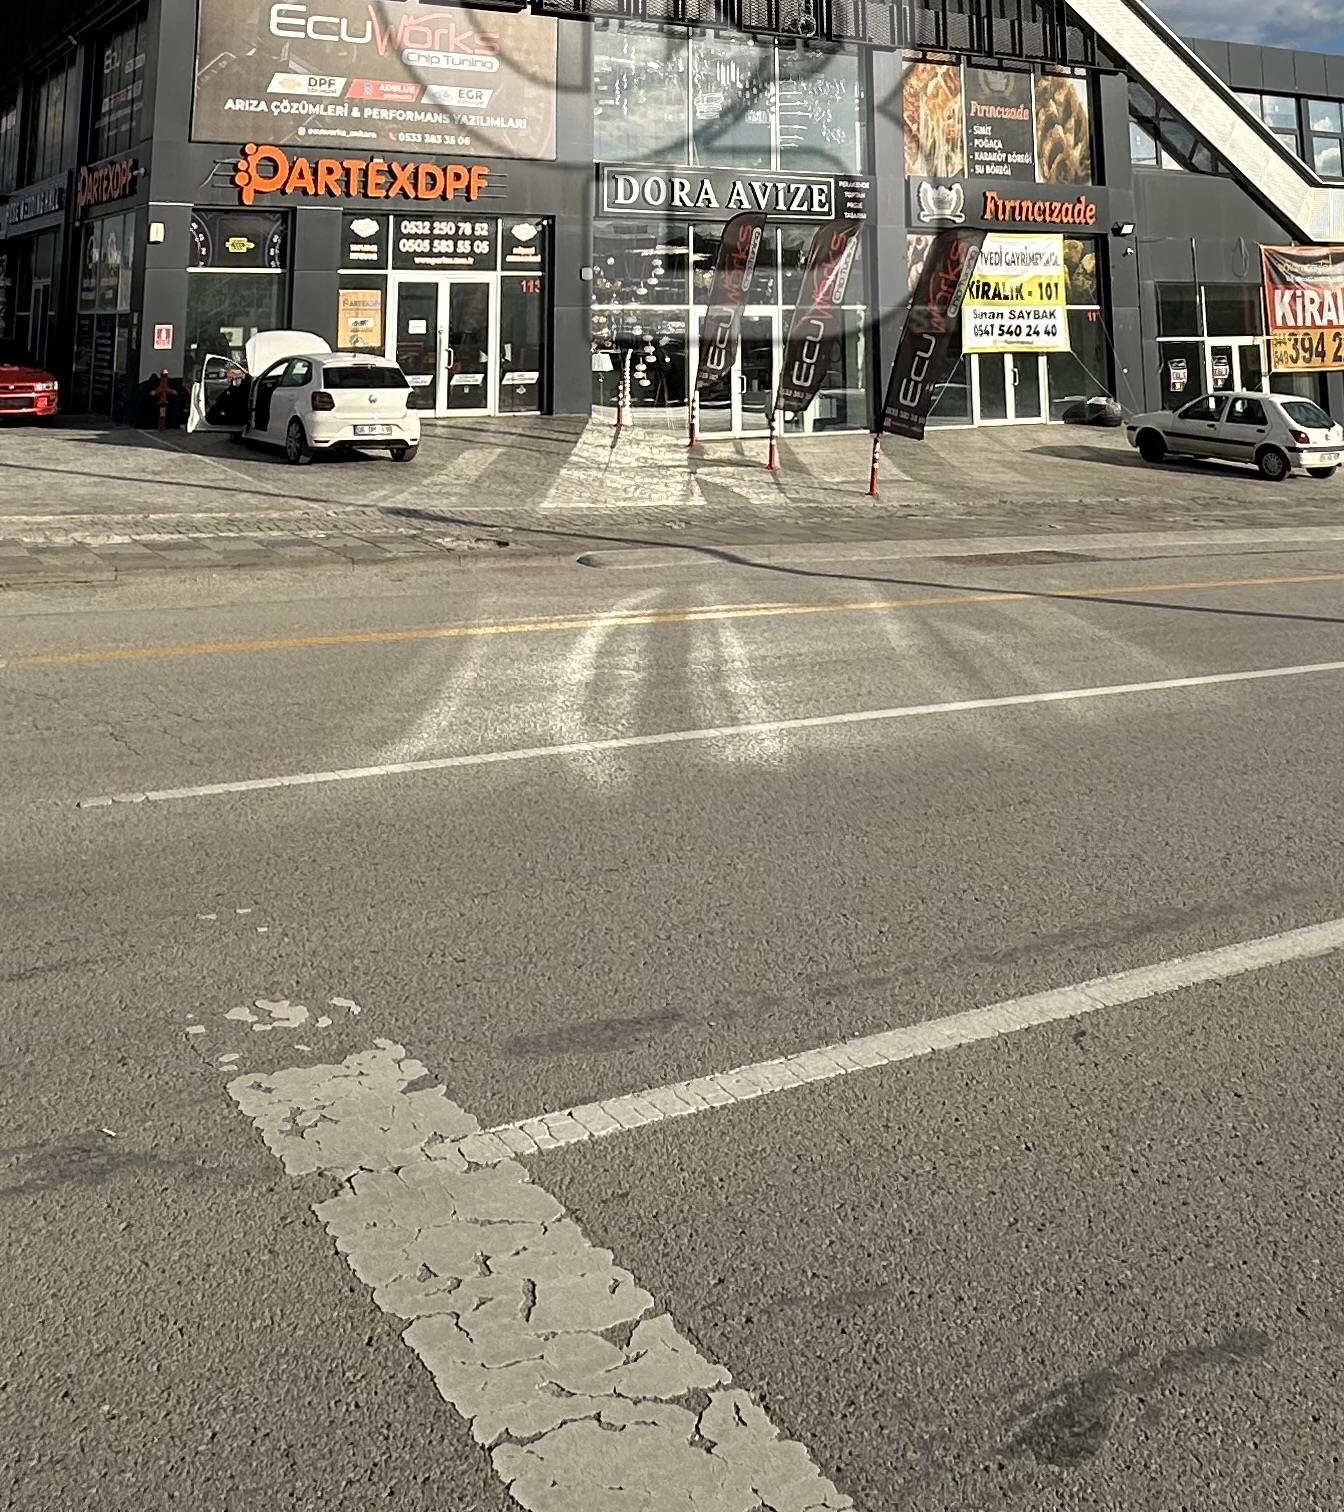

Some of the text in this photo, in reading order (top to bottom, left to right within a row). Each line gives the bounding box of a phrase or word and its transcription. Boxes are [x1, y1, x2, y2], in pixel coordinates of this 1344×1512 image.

[406, 51, 494, 70] Chip Tuning
[308, 77, 336, 88] DPF
[458, 89, 484, 100] EGR
[224, 99, 527, 129] ARIZA ÇÖZÜMLERİ & PERFORMANS YAZILIMLARI
[974, 137, 1003, 150] POĞAÇA
[235, 142, 491, 205] PARTEXDPF
[975, 164, 984, 175] SU
[614, 174, 720, 208] DORA
[983, 191, 1097, 225] Fırıncızade
[400, 220, 431, 236] 0532
[433, 221, 455, 236] 250
[474, 222, 489, 236] 52
[399, 239, 431, 254] 0505
[432, 240, 454, 254] 583
[456, 240, 471, 254] 55
[473, 240, 489, 254] 05
[968, 279, 1025, 301] KİRALIK
[1039, 281, 1060, 301] 101
[973, 308, 1057, 321] Sinan SAYBAK
[973, 324, 1058, 338] 0541 540 24 40
[1288, 332, 1326, 365] 394
